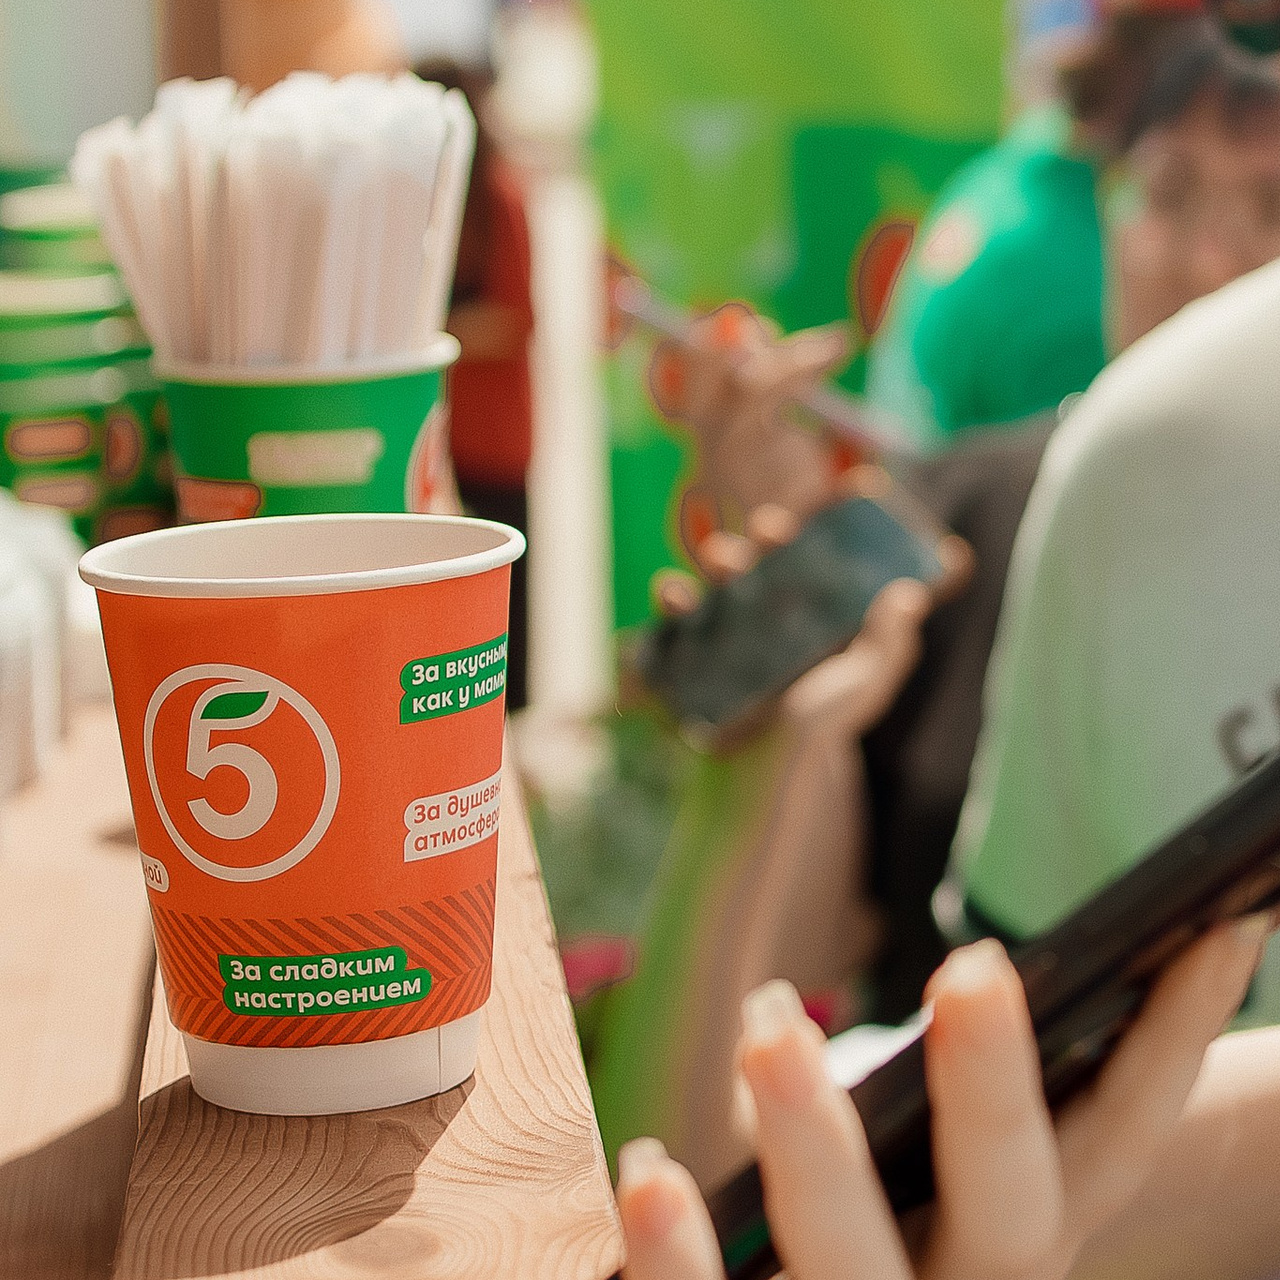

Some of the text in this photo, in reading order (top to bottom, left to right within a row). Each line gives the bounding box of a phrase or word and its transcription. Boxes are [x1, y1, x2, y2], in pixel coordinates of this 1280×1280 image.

[412, 663, 440, 686] За
[412, 689, 453, 714] как
[458, 685, 470, 708] у
[186, 682, 278, 841] 5
[413, 803, 440, 824] За
[230, 955, 395, 982] За сладким
[234, 977, 421, 1013] настроением
